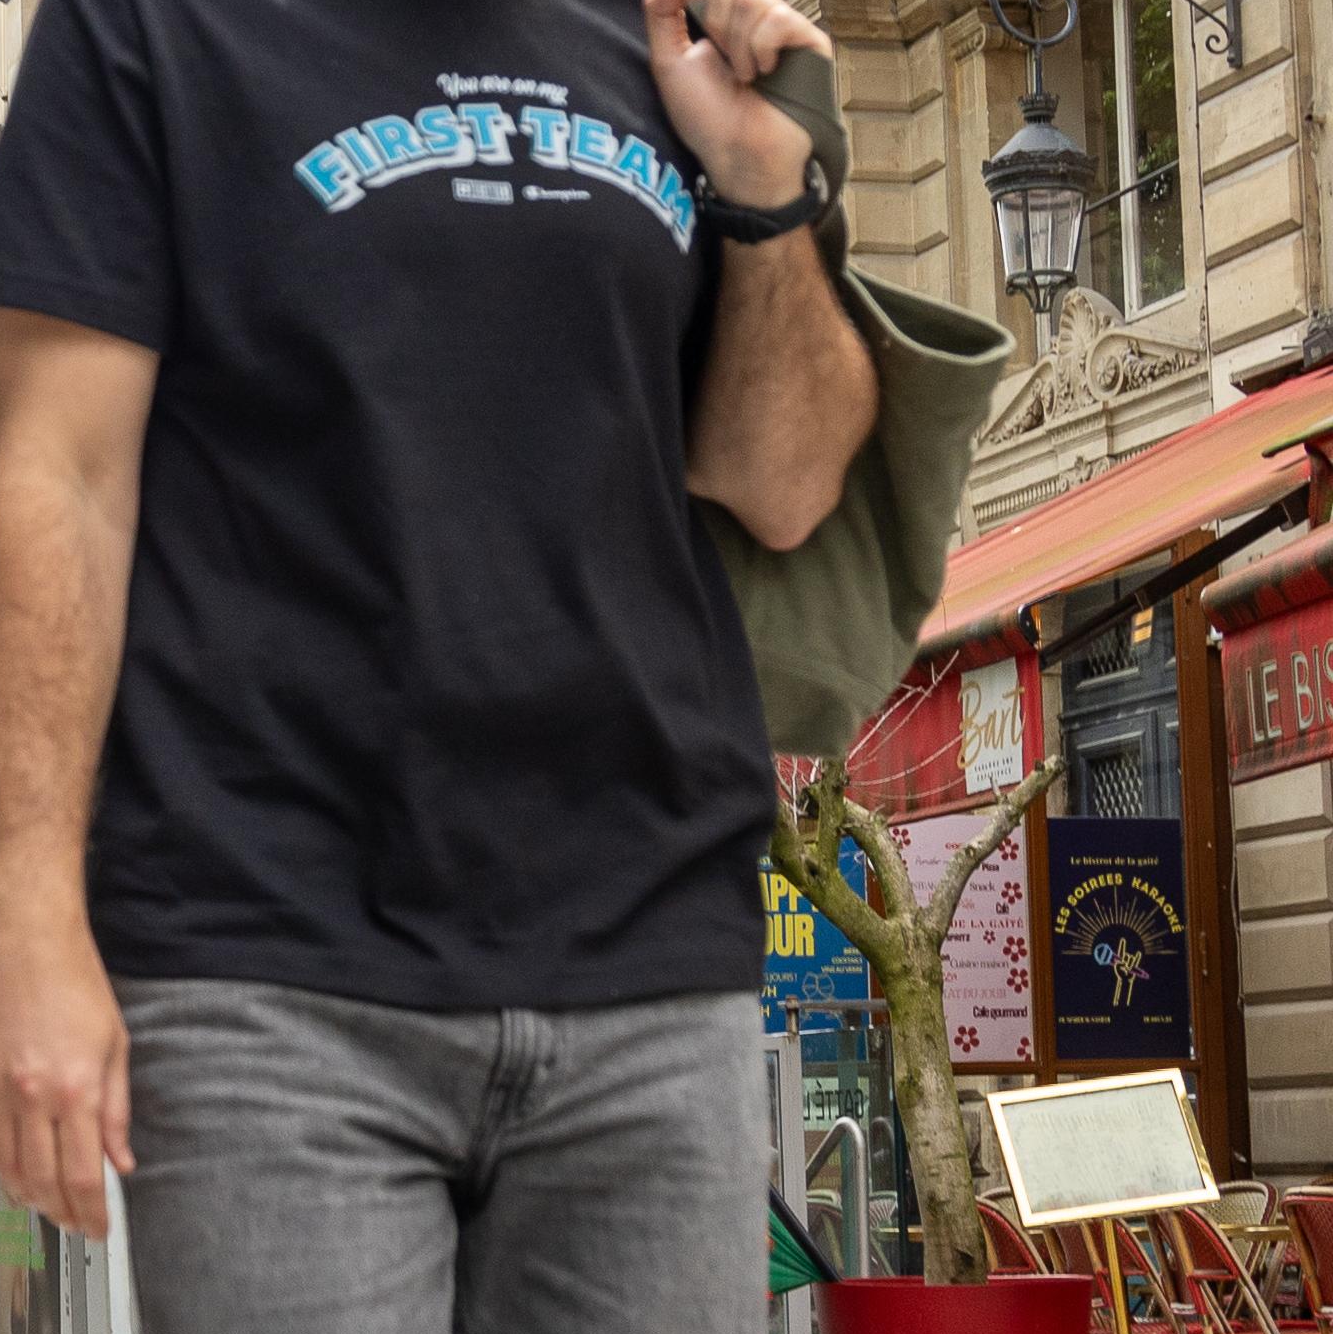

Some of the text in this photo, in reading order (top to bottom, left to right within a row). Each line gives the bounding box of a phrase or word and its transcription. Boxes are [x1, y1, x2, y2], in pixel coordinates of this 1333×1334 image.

[293, 102, 696, 255] FIRST TEAM
[1246, 659, 1282, 743] LE
[957, 680, 1026, 768] Bart
[1071, 856, 1081, 866] Le
[764, 913, 815, 957] OUR
[971, 919, 984, 928] LA
[1055, 906, 1071, 934] LES
[991, 1006, 1028, 1020] gourmand
